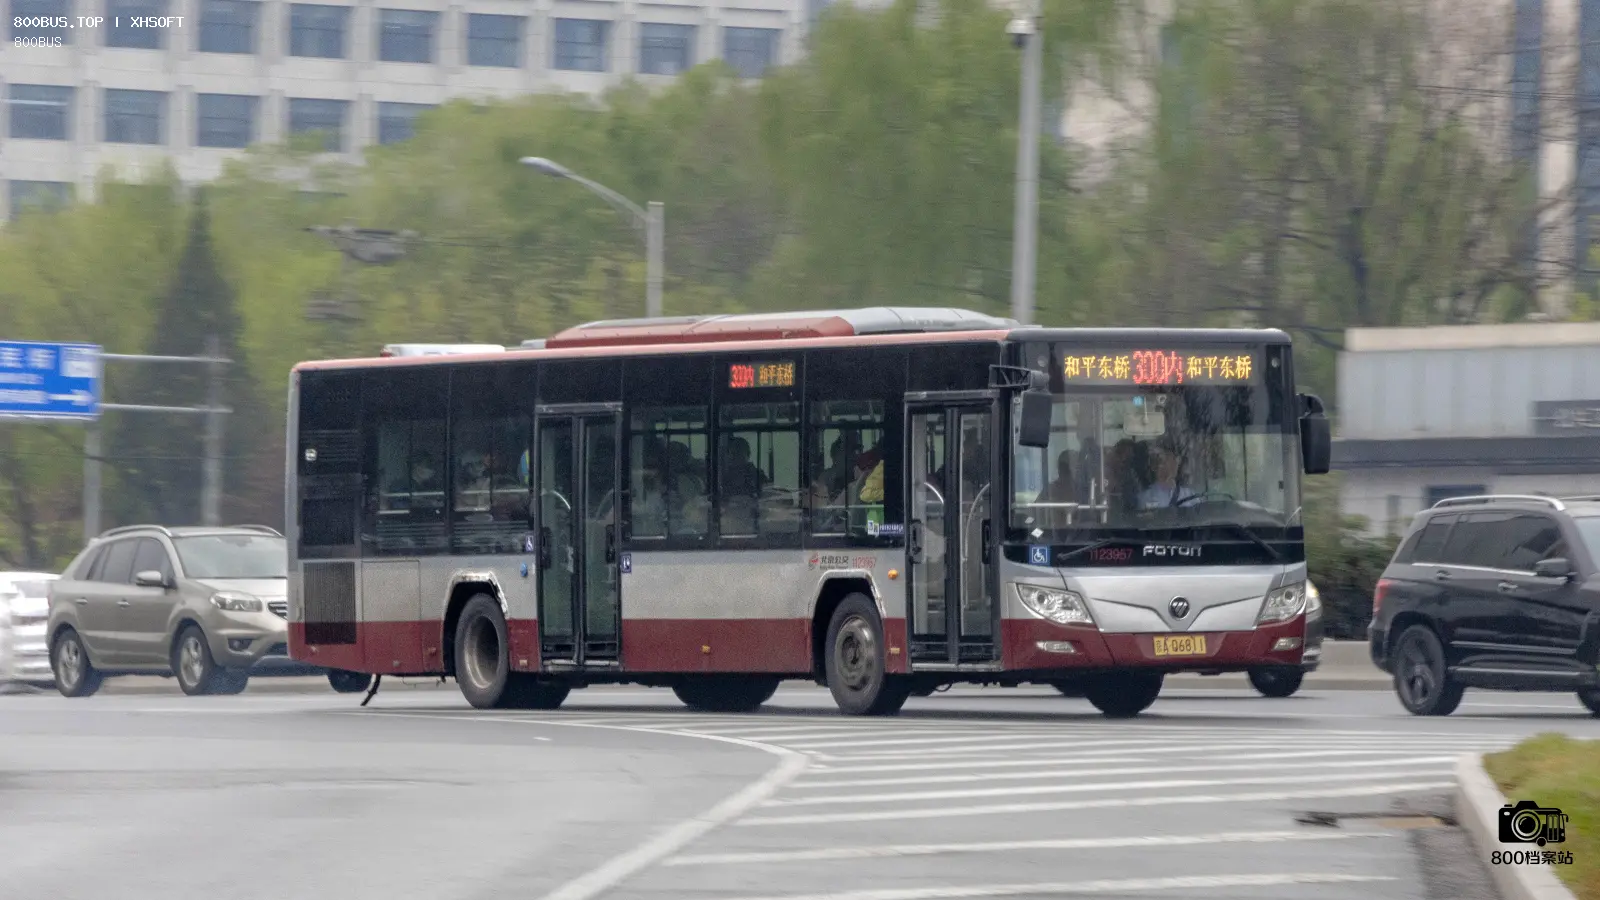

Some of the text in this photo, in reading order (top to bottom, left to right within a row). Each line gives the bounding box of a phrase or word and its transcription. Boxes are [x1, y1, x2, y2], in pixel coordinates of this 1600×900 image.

[1064, 350, 1252, 384] 和平东桥 300内 和平东桥
[1142, 545, 1203, 557] FOTON
